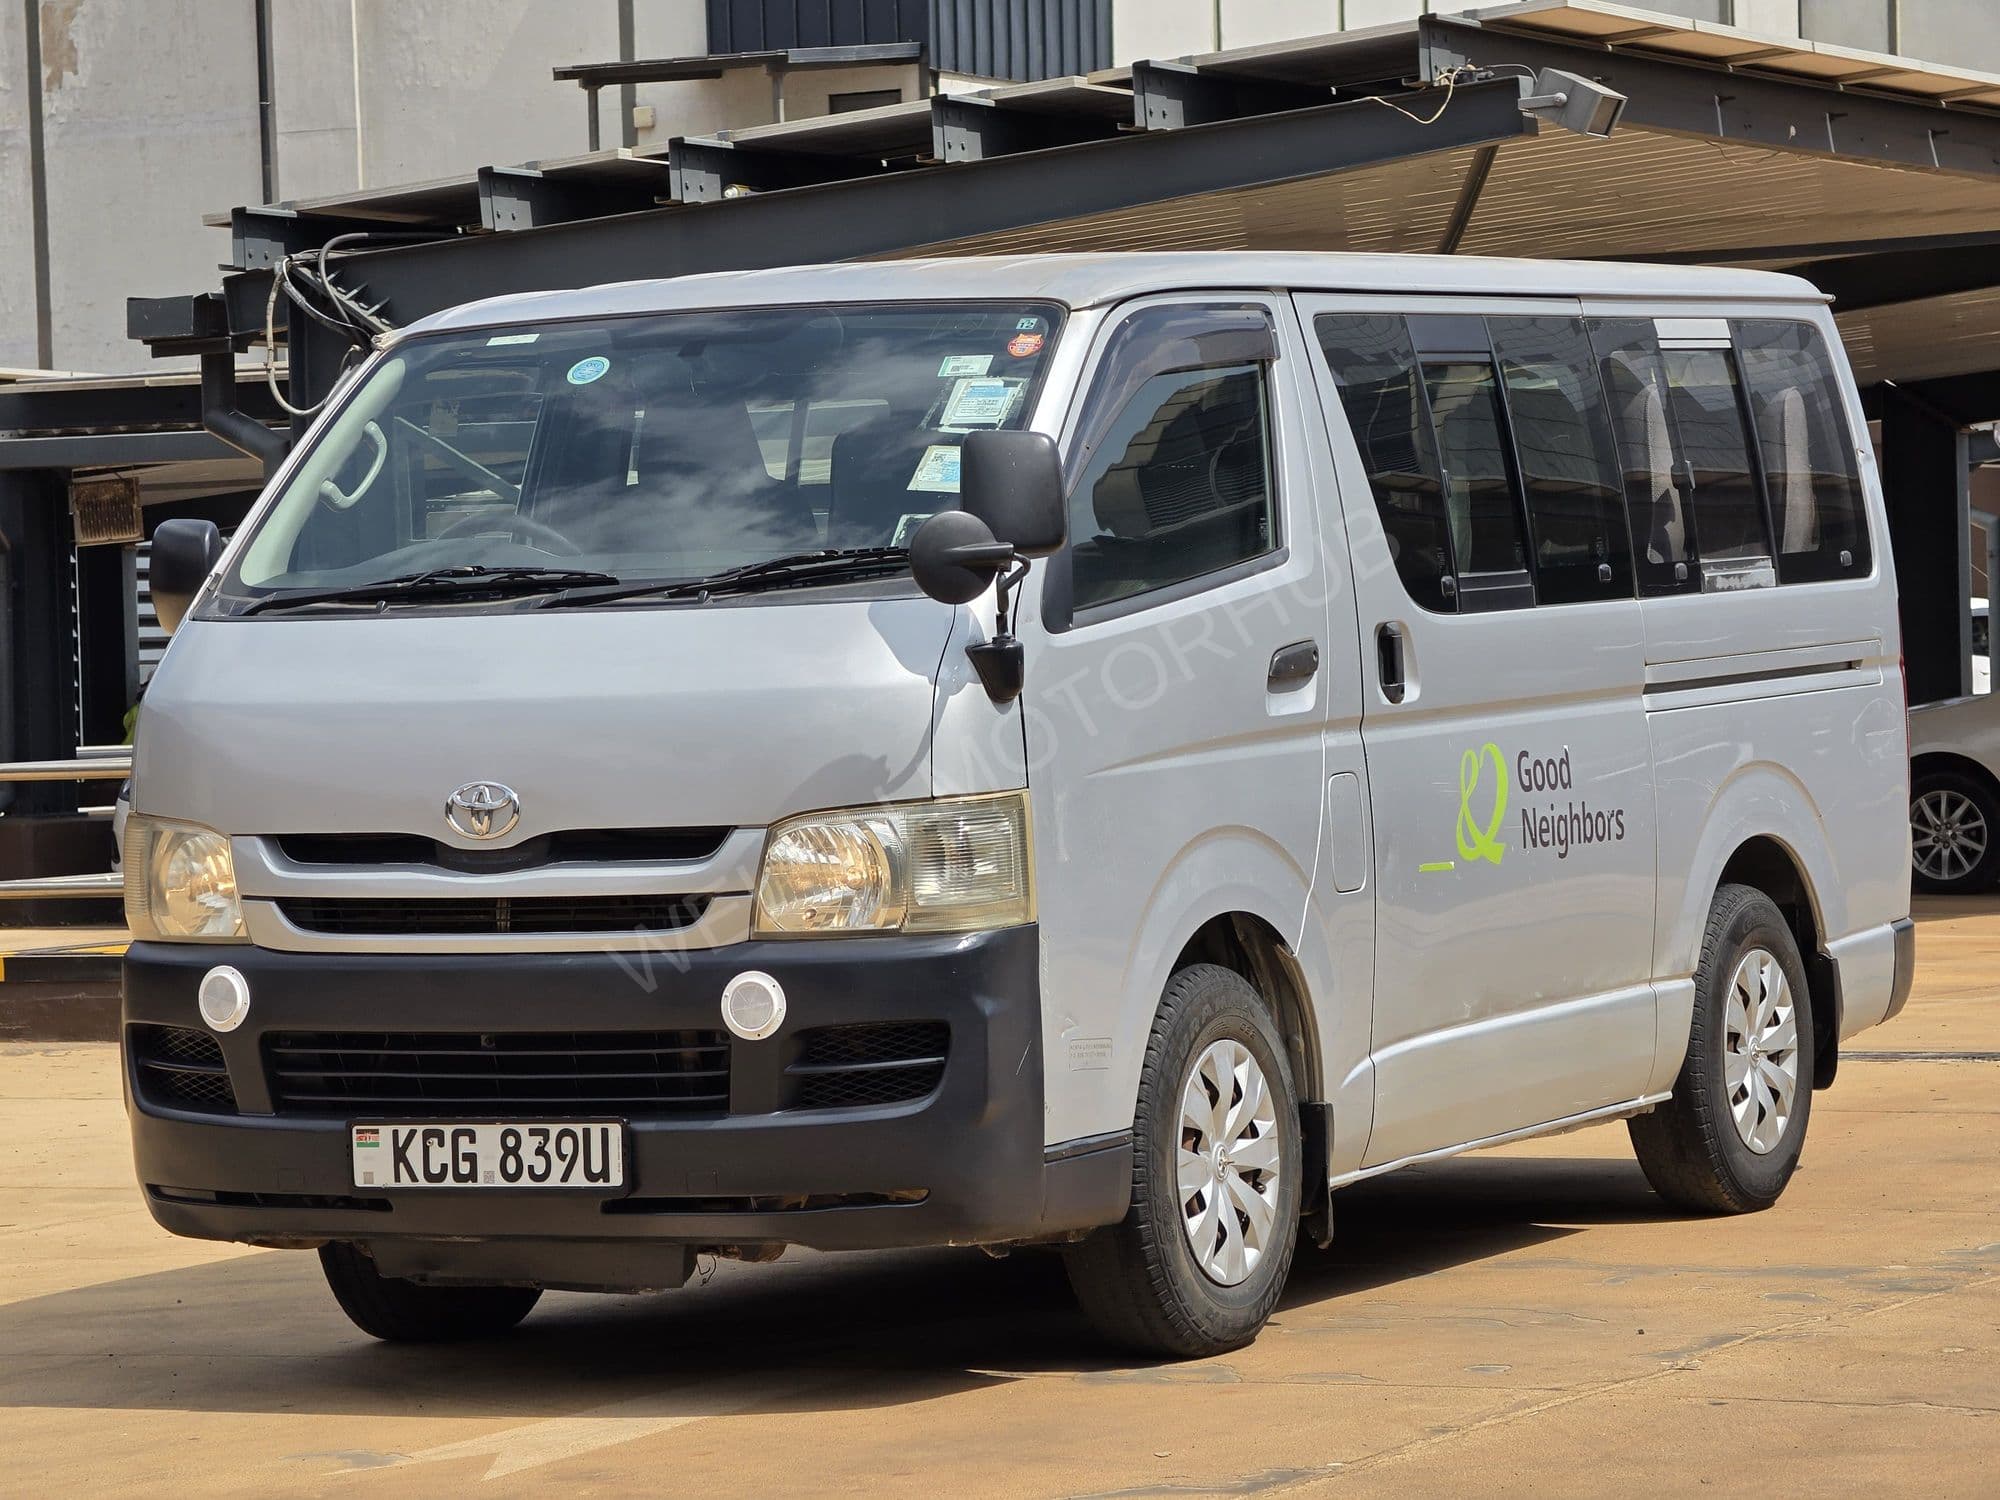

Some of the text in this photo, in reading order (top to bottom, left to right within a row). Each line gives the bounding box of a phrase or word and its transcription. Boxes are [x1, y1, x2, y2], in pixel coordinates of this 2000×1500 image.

[1517, 746, 1572, 793] Good
[1521, 801, 1625, 859] Neighbors
[392, 1127, 478, 1184] KCG
[499, 1127, 611, 1184] 839U
